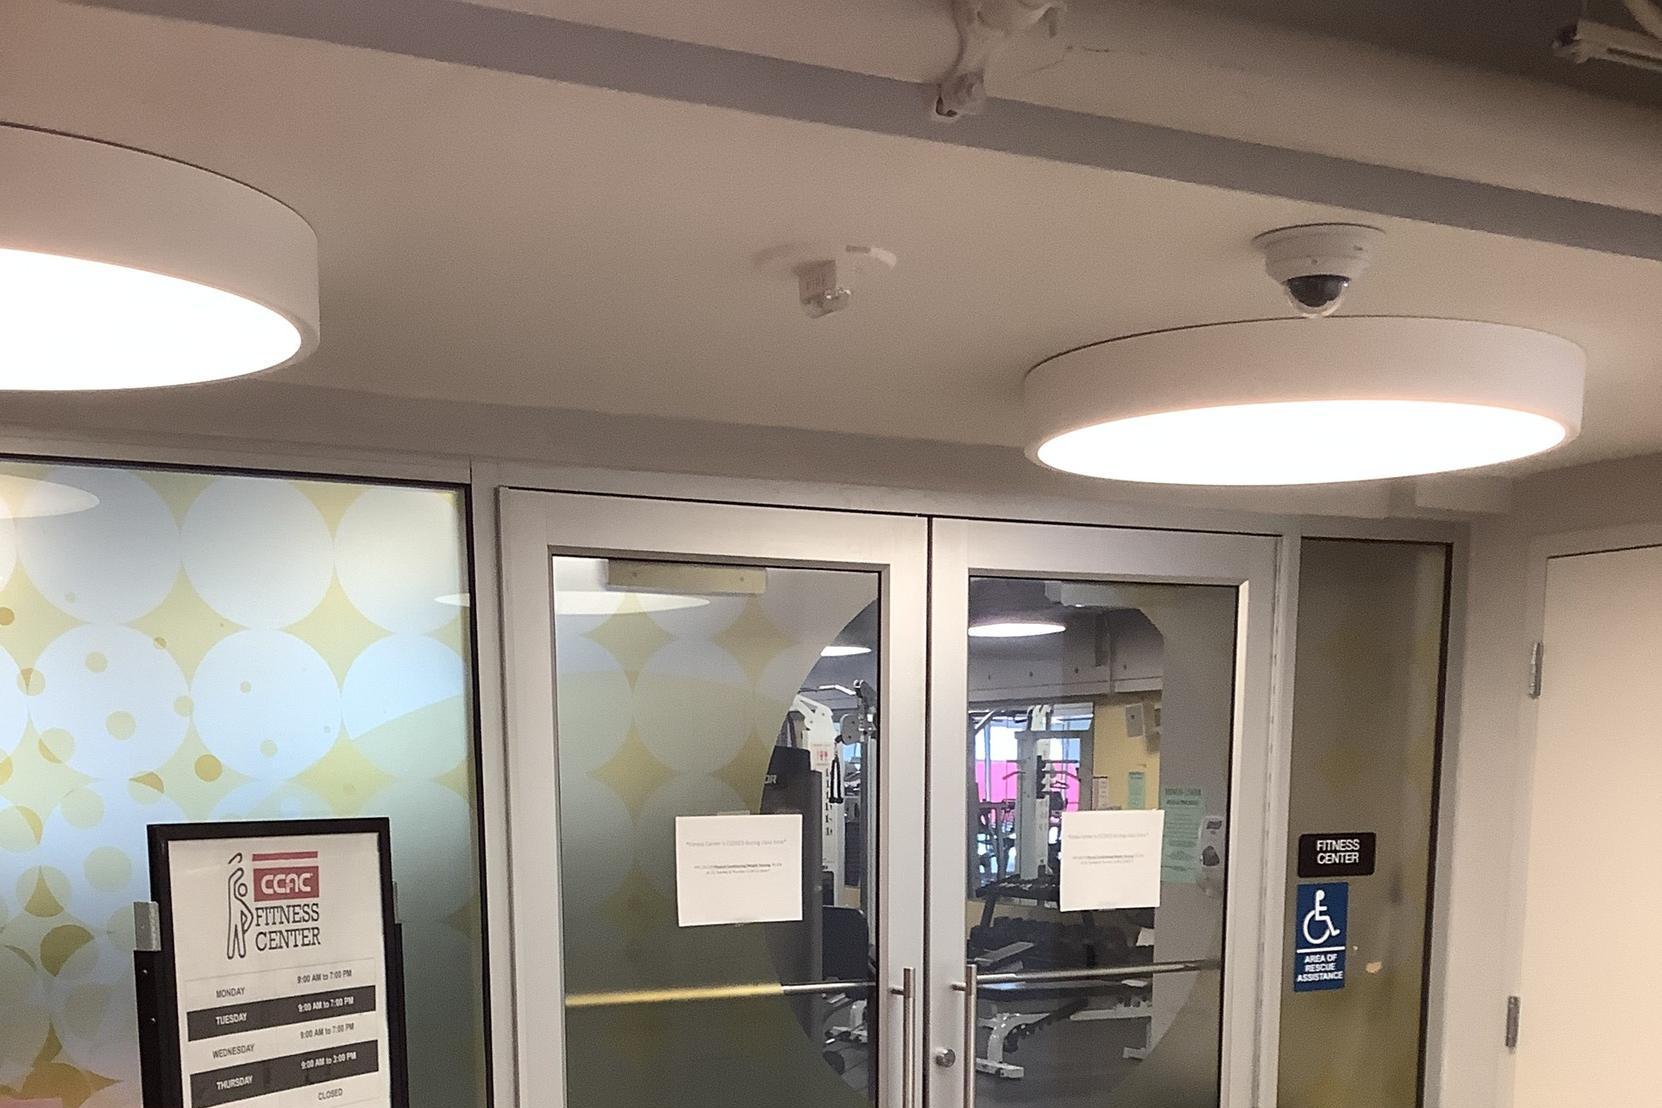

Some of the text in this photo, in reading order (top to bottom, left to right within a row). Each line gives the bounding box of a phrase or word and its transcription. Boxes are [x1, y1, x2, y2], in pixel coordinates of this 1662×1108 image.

[1317, 839, 1360, 851] FITNESS
[1317, 852, 1359, 864] CENTER
[261, 873, 313, 895] CCAC
[255, 903, 320, 927] FITNESS
[255, 926, 321, 951] CENTER
[1304, 954, 1338, 964] AREA OF
[1305, 963, 1336, 972] RESCUE
[312, 973, 322, 982] AM
[330, 971, 342, 980] 7:00
[343, 969, 352, 977] PM
[1296, 971, 1344, 982] ASSISTANCE
[216, 986, 246, 998] MONDAY
[312, 1001, 322, 1010] AM
[330, 998, 343, 1007] 7:00
[344, 996, 354, 1005] PM
[216, 1012, 248, 1026] TUESDAY
[314, 1028, 324, 1036] AM
[345, 1022, 354, 1030] PM
[212, 1043, 255, 1059] WEDNESDAY
[315, 1057, 325, 1067] AM
[346, 1051, 356, 1060] PM
[216, 1075, 254, 1090] THURSDAY
[318, 1088, 343, 1101] CLOSED
